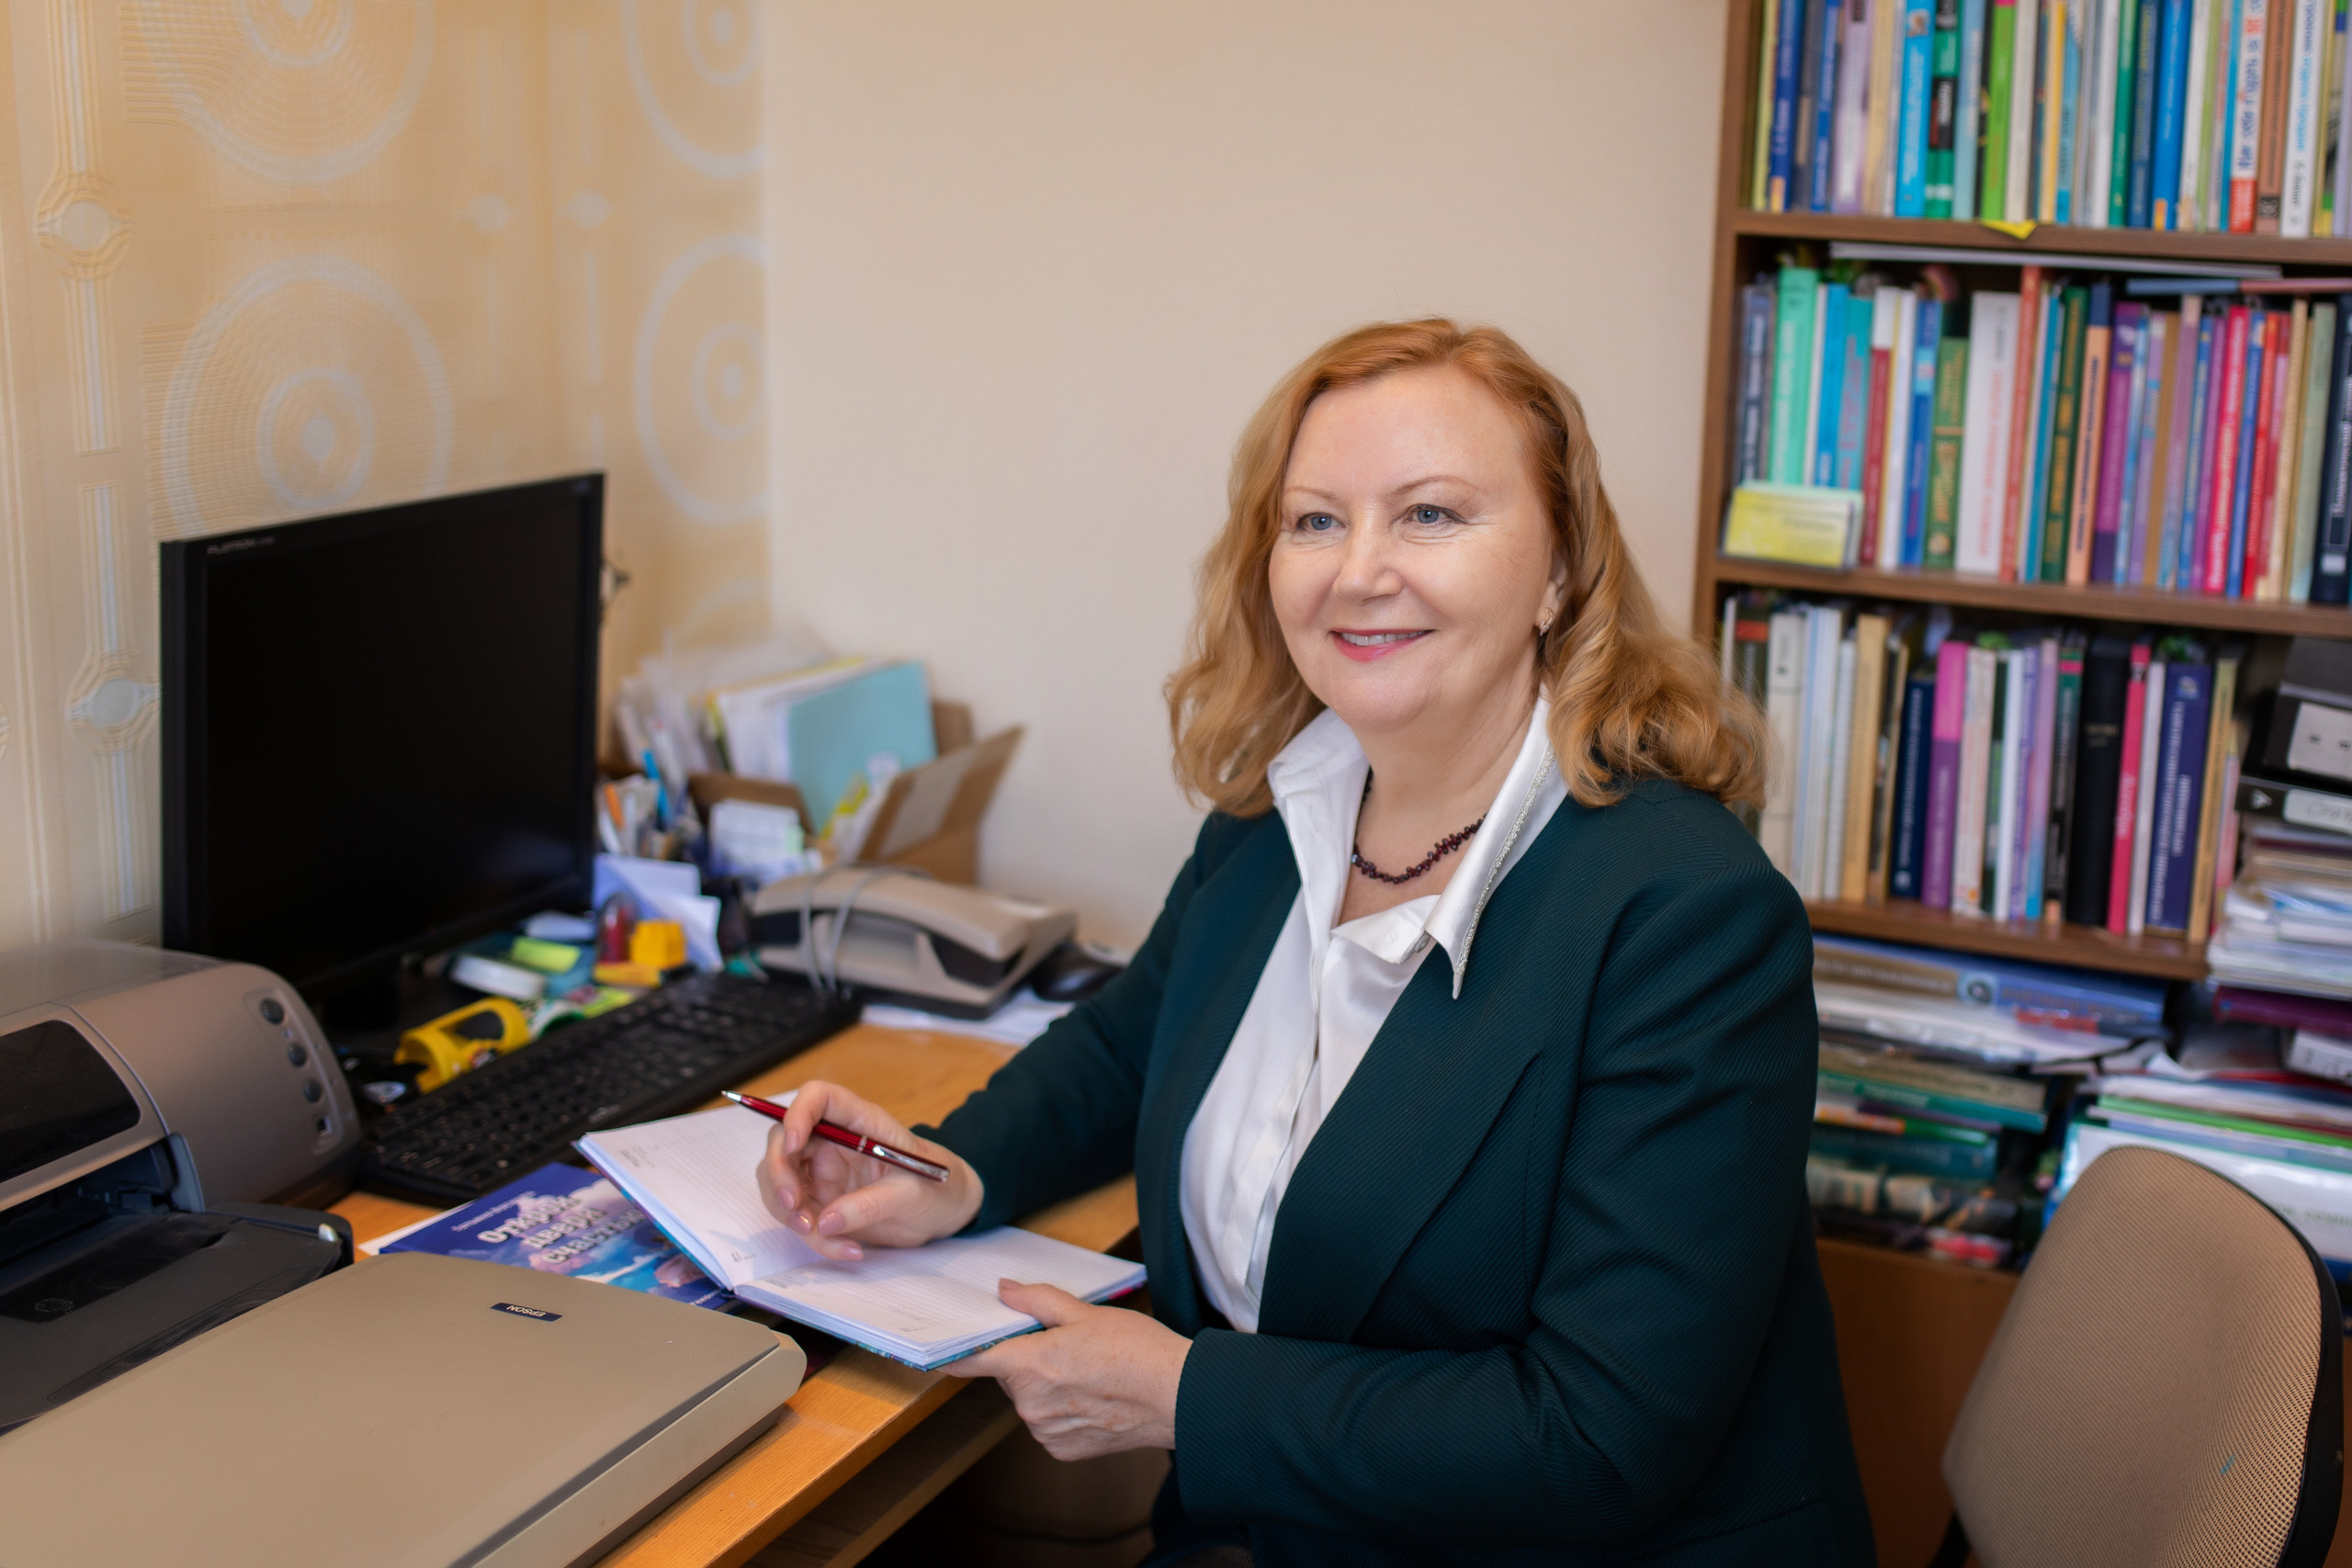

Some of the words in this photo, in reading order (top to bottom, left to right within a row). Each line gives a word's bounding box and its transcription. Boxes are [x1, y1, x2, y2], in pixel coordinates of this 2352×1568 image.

[521, 1207, 608, 1249] двери
[541, 1209, 647, 1264] счастью
[507, 1305, 547, 1318] EPSON
